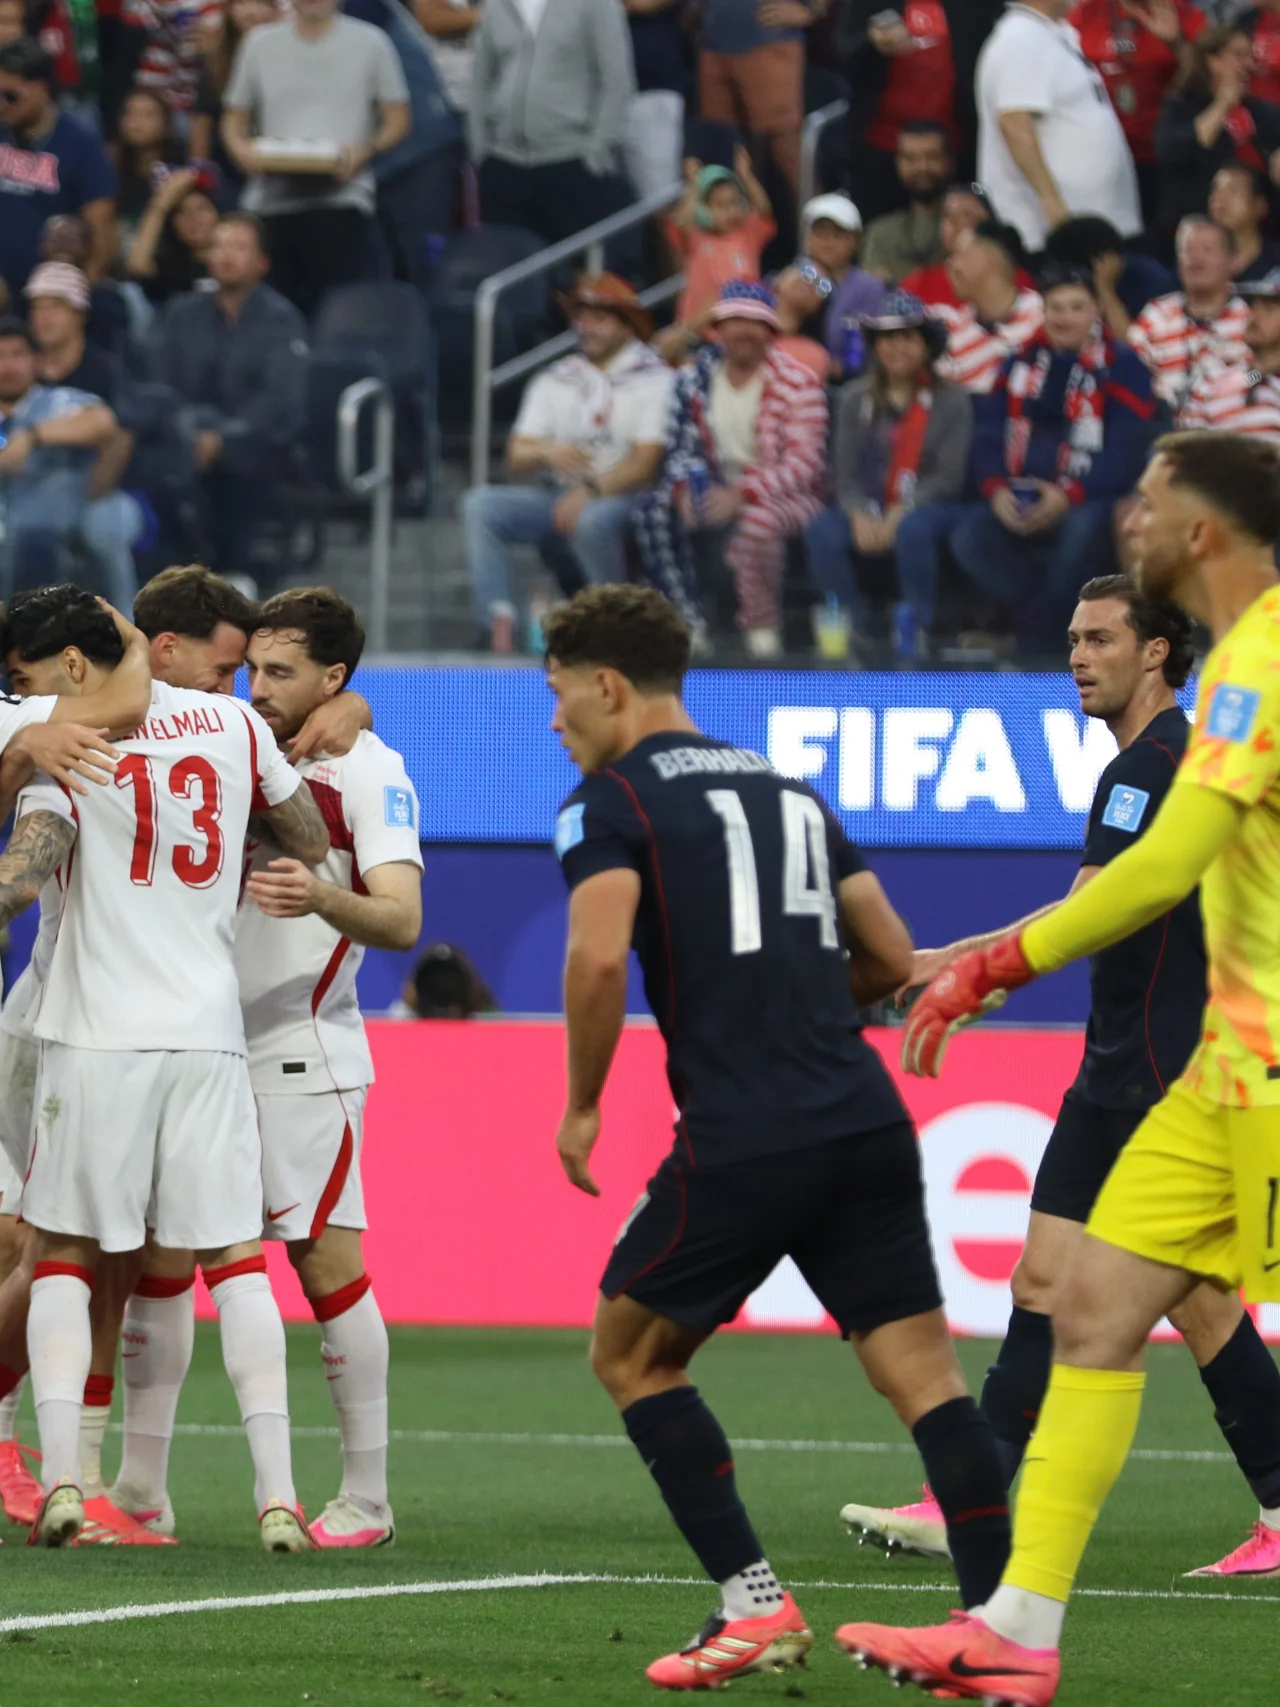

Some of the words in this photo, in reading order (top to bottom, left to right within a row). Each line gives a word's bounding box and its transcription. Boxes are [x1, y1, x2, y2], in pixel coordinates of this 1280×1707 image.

[149, 707, 224, 740] ELMALI
[767, 706, 1027, 813] FIFA
[114, 754, 225, 890] 13
[704, 788, 838, 956] 14
